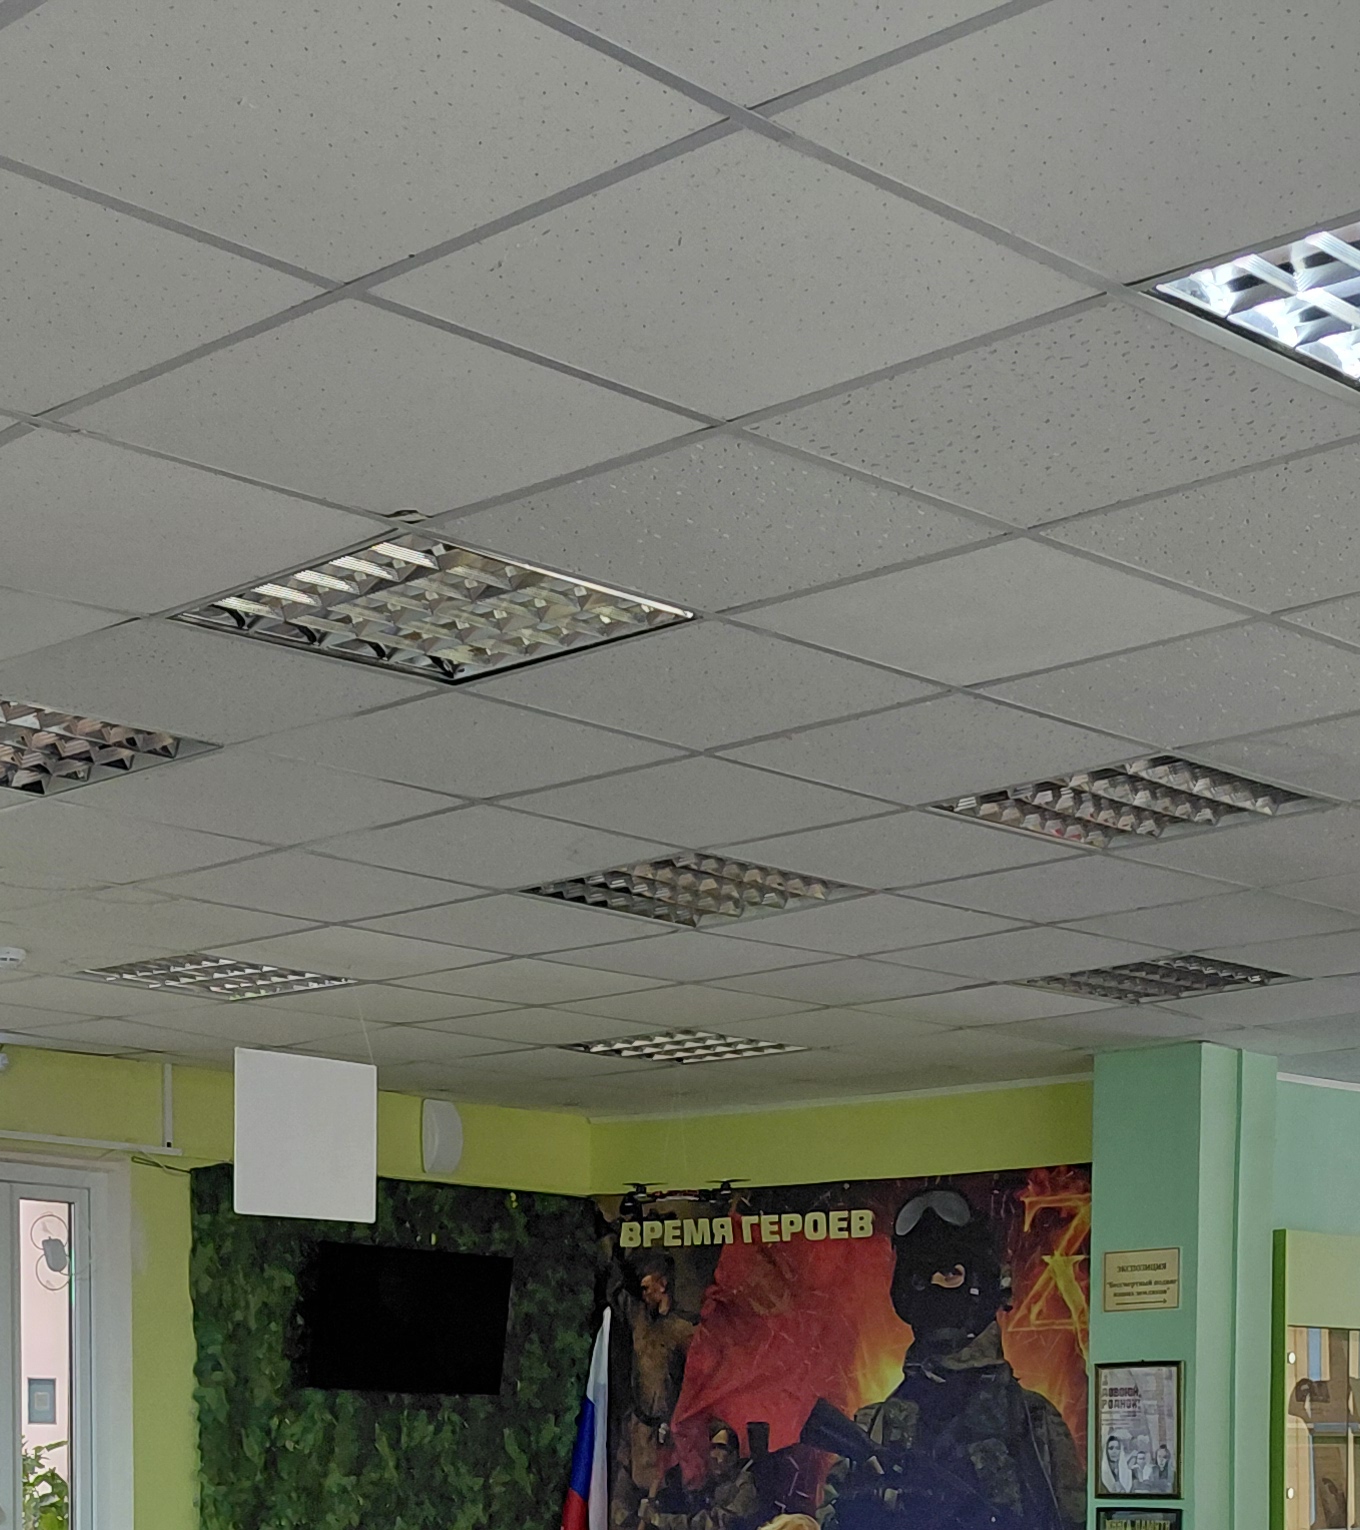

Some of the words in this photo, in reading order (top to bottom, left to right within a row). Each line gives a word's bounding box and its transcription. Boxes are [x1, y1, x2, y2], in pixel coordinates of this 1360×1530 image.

[620, 1217, 733, 1247] ВРЕМЯ
[741, 1209, 874, 1243] ГЕРОЕВ
[1117, 1262, 1167, 1273] ЭКСПОЗИЦИЯ
